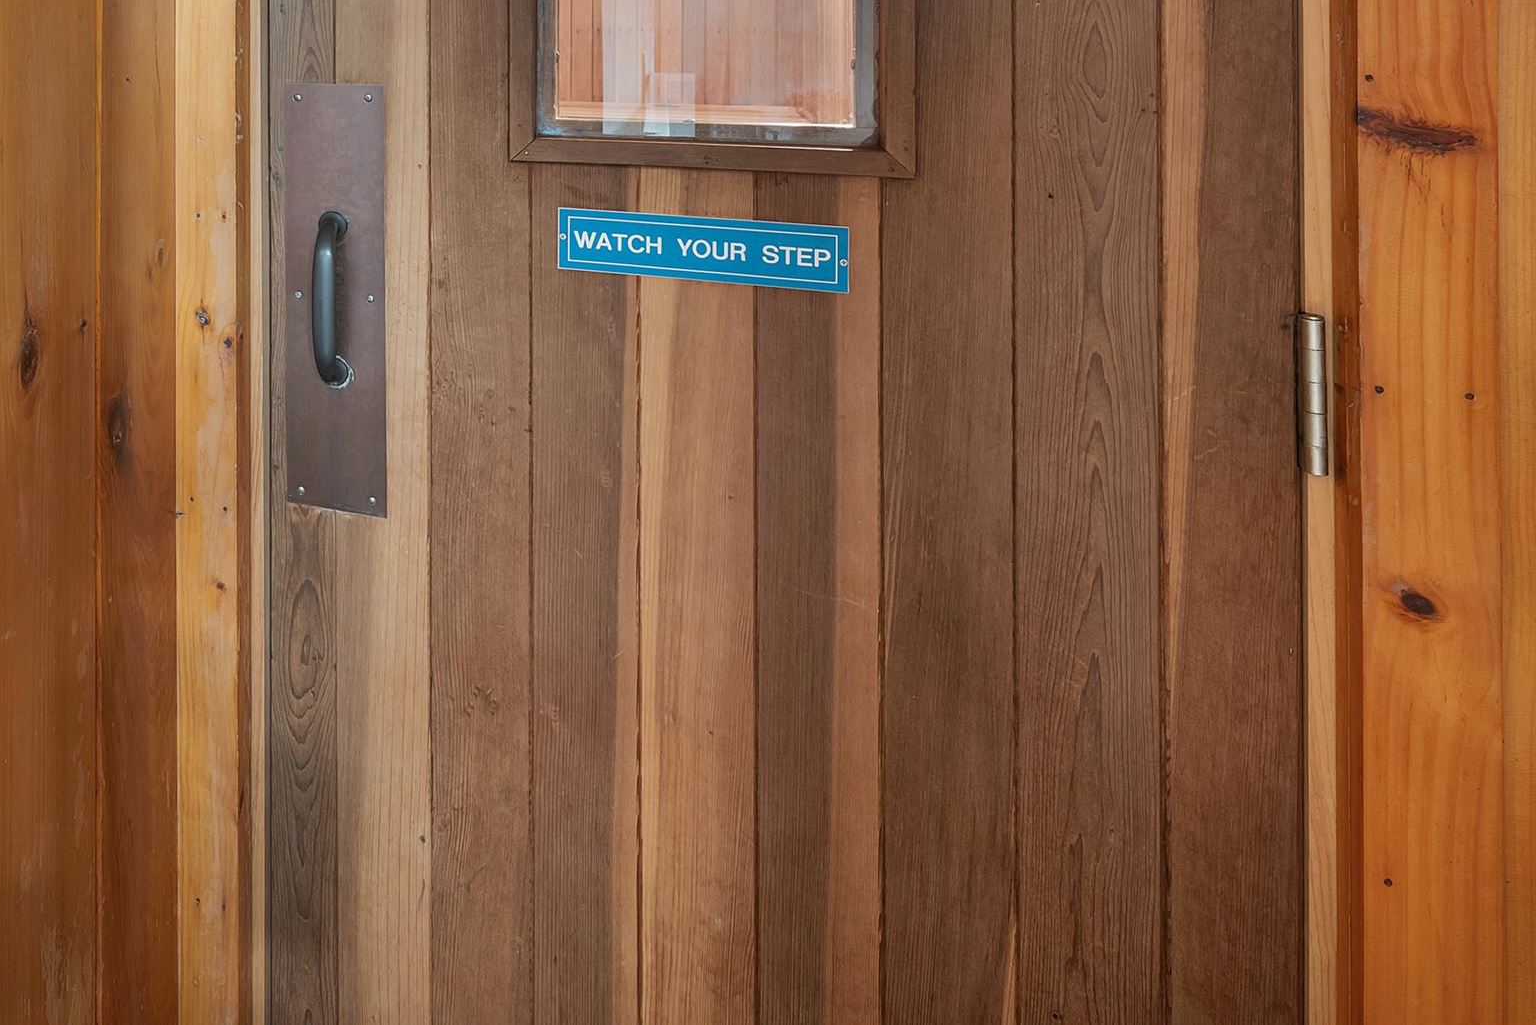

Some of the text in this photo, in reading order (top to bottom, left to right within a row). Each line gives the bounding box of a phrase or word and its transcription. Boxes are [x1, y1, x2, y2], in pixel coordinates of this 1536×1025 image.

[573, 230, 832, 268] WATCH YOUR STEP
